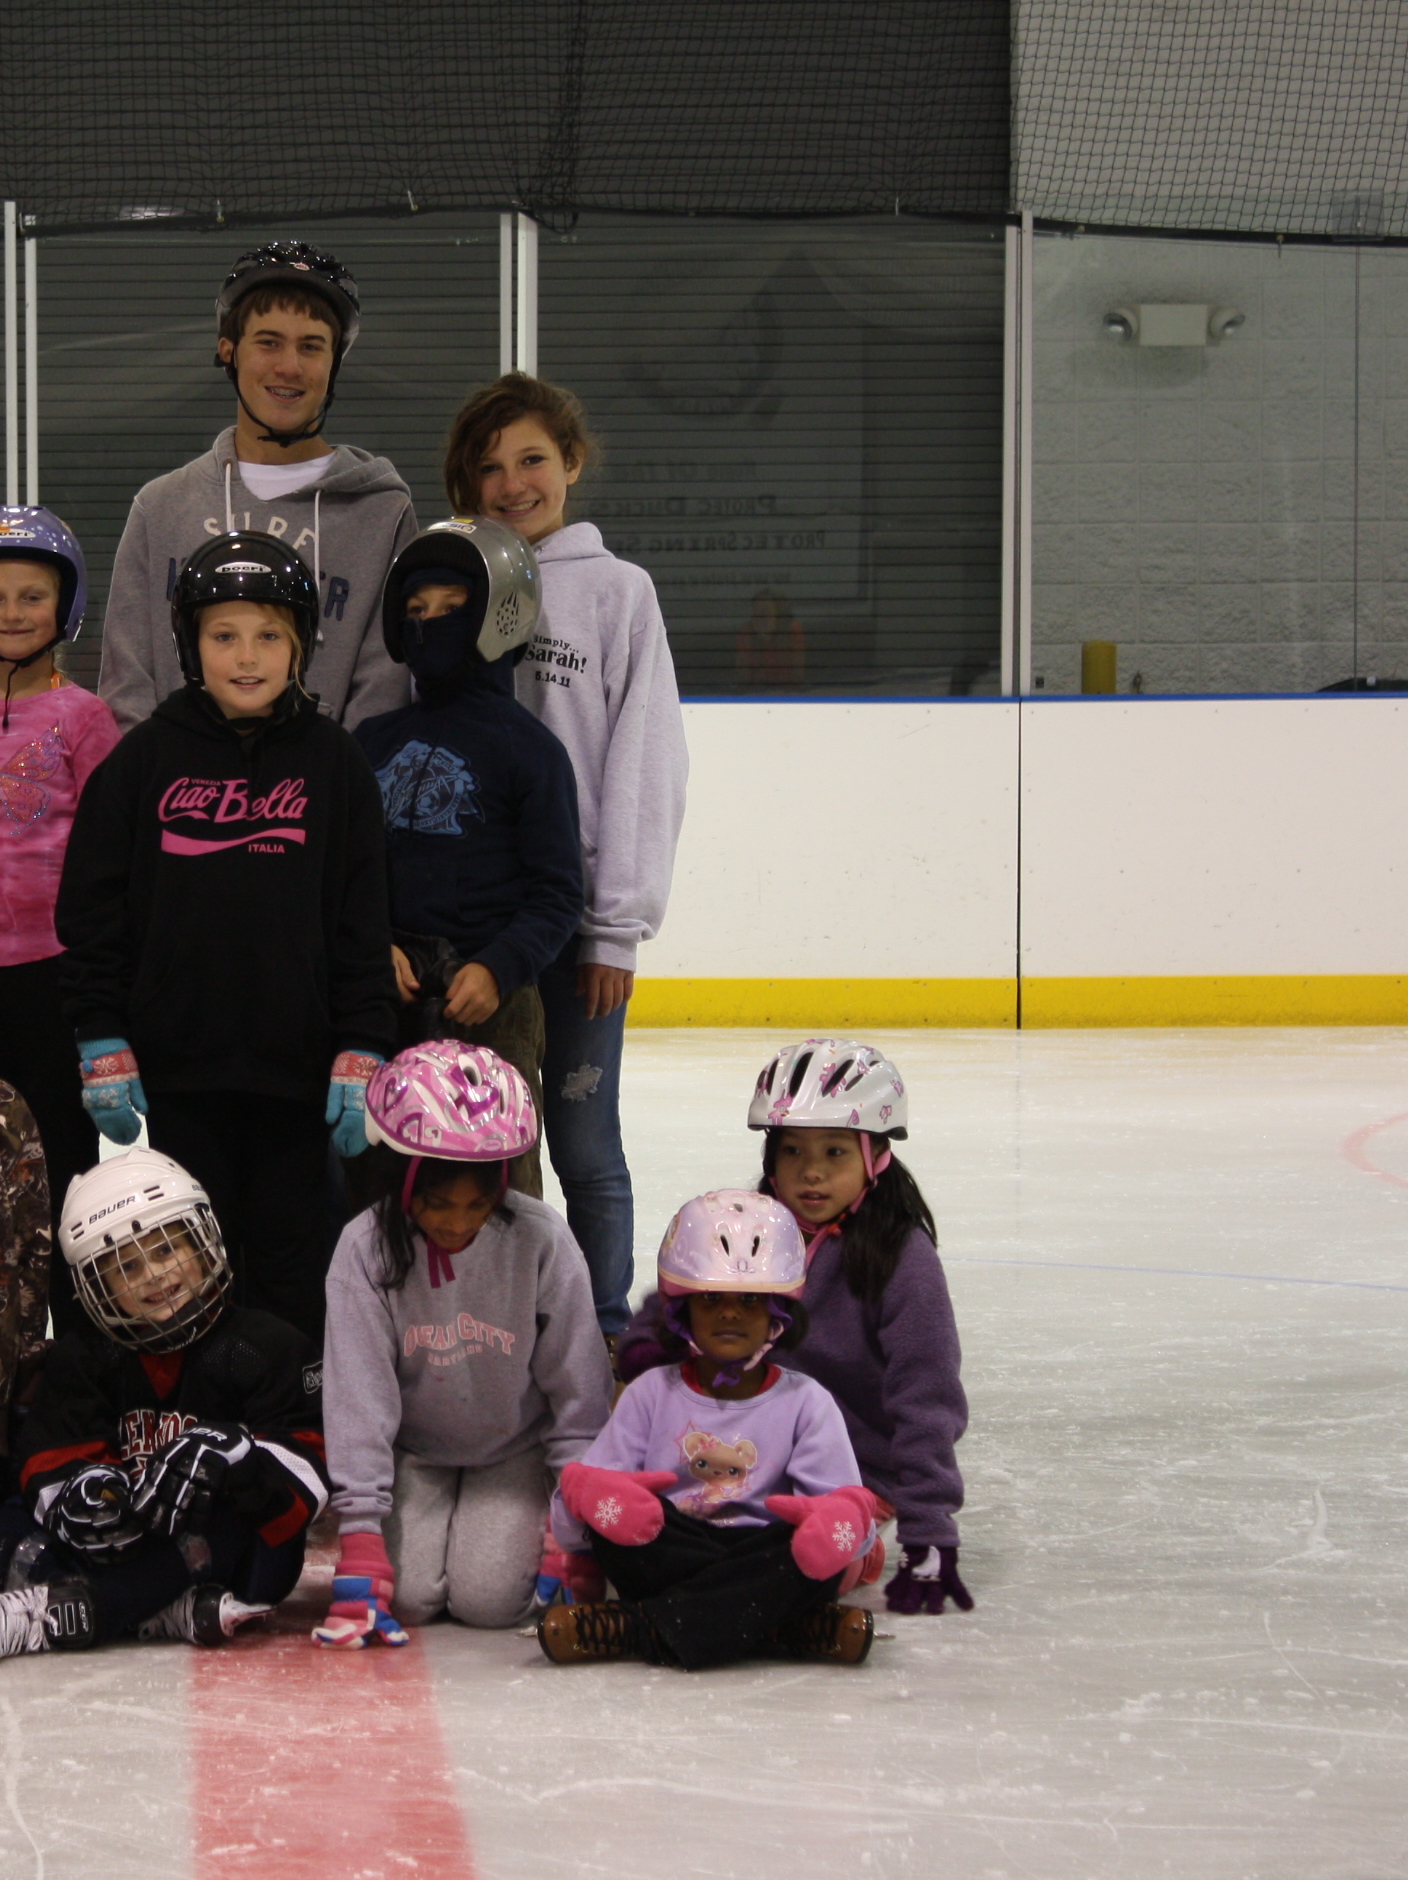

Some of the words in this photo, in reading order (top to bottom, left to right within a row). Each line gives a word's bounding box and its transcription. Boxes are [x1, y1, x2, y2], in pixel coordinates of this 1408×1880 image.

[158, 777, 221, 823] Ciao
[213, 778, 309, 823] Bella
[248, 844, 286, 854] ITALIA
[457, 1313, 516, 1356] CITY
